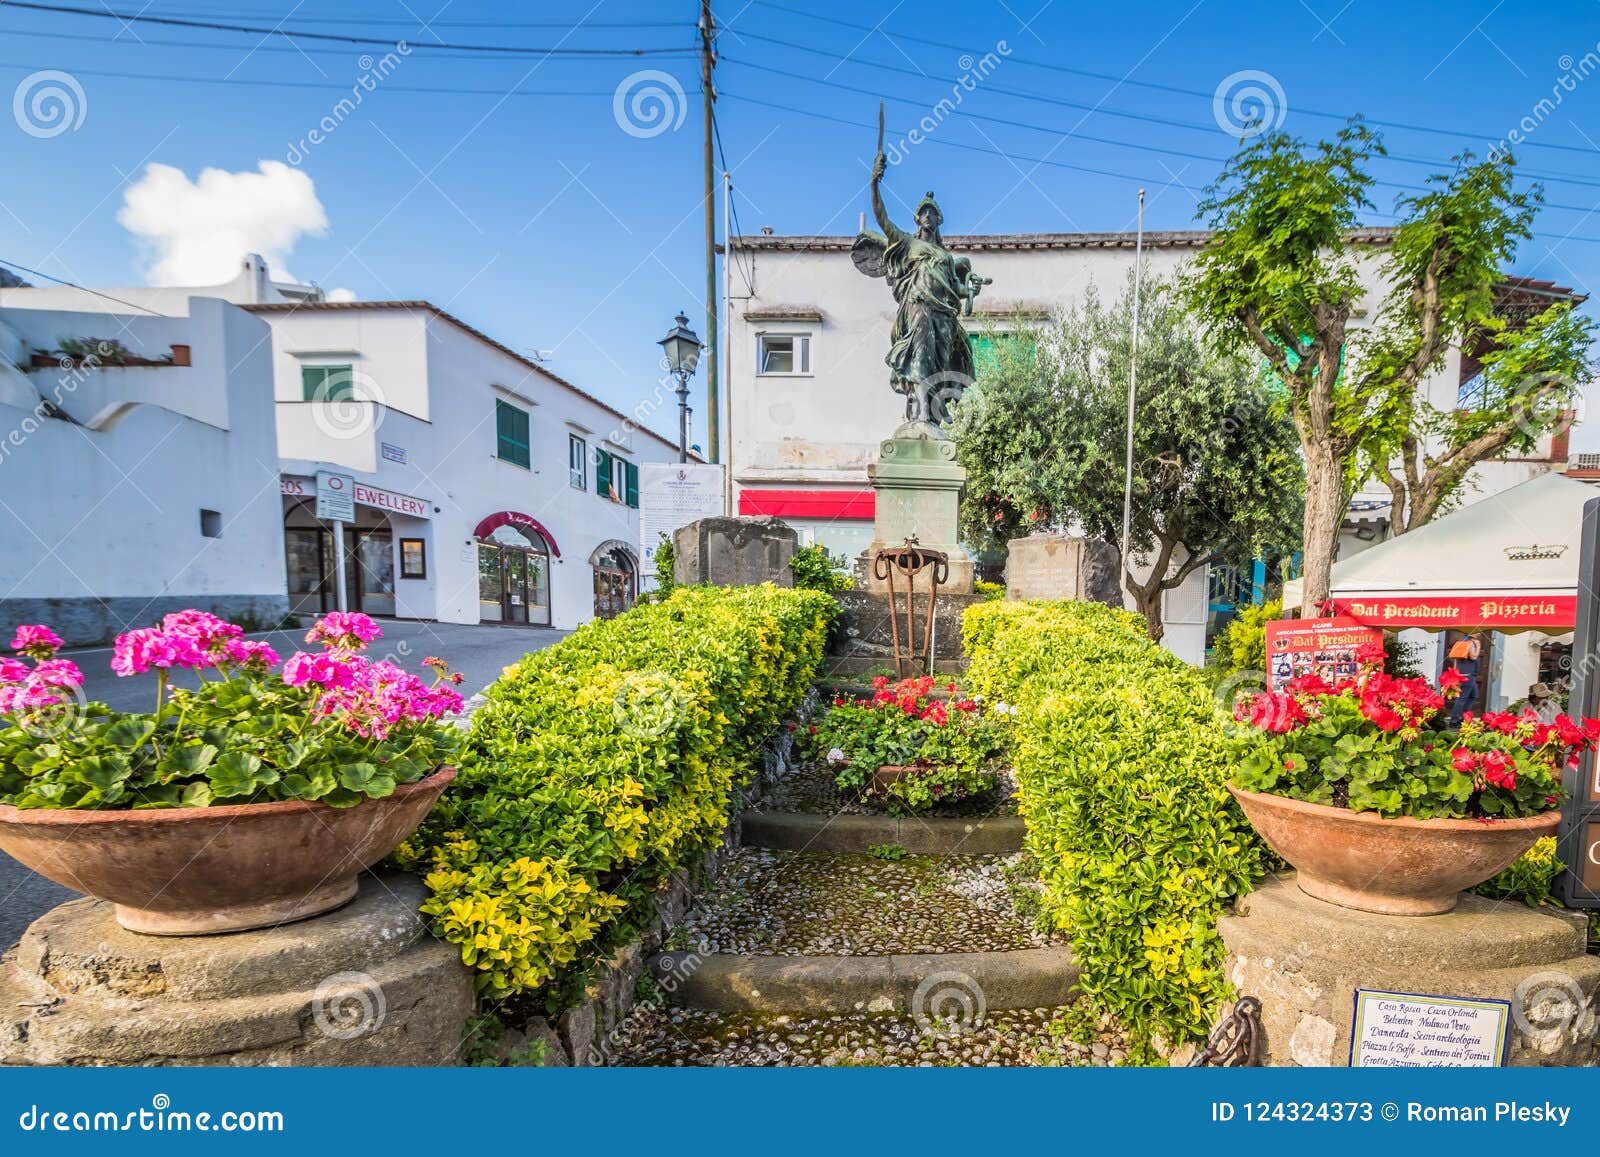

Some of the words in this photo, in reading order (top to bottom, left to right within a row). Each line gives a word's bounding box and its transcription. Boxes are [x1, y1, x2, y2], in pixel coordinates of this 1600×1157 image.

[1351, 604, 1379, 617] Dal
[1383, 604, 1460, 619] Presidente
[1479, 600, 1556, 618] Pizzeria
[1293, 635, 1314, 647] Dal
[1378, 1001, 1397, 1011] Casa
[1428, 1006, 1447, 1015] Casa
[1362, 1040, 1387, 1051] Piazza
